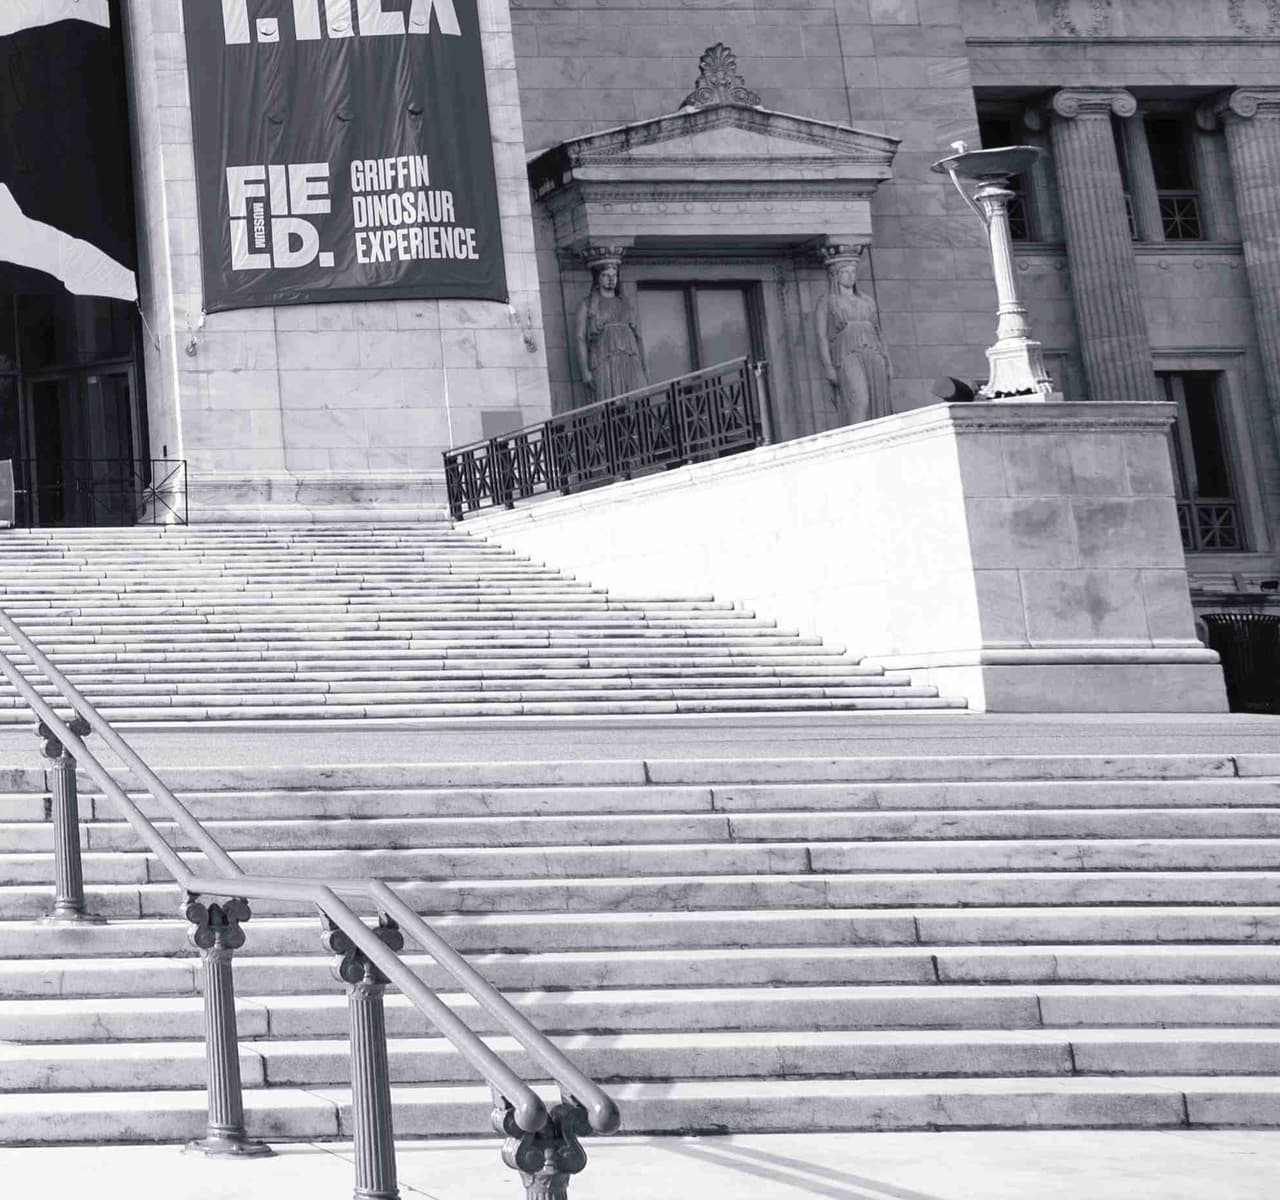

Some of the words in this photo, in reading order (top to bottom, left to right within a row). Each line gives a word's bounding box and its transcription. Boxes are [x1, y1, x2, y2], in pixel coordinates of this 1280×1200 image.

[350, 154, 430, 193] GRIFFIN
[252, 202, 266, 249] MUSEUM
[352, 190, 456, 228] DINOSAUR
[354, 226, 480, 264] EXPERIENCE
